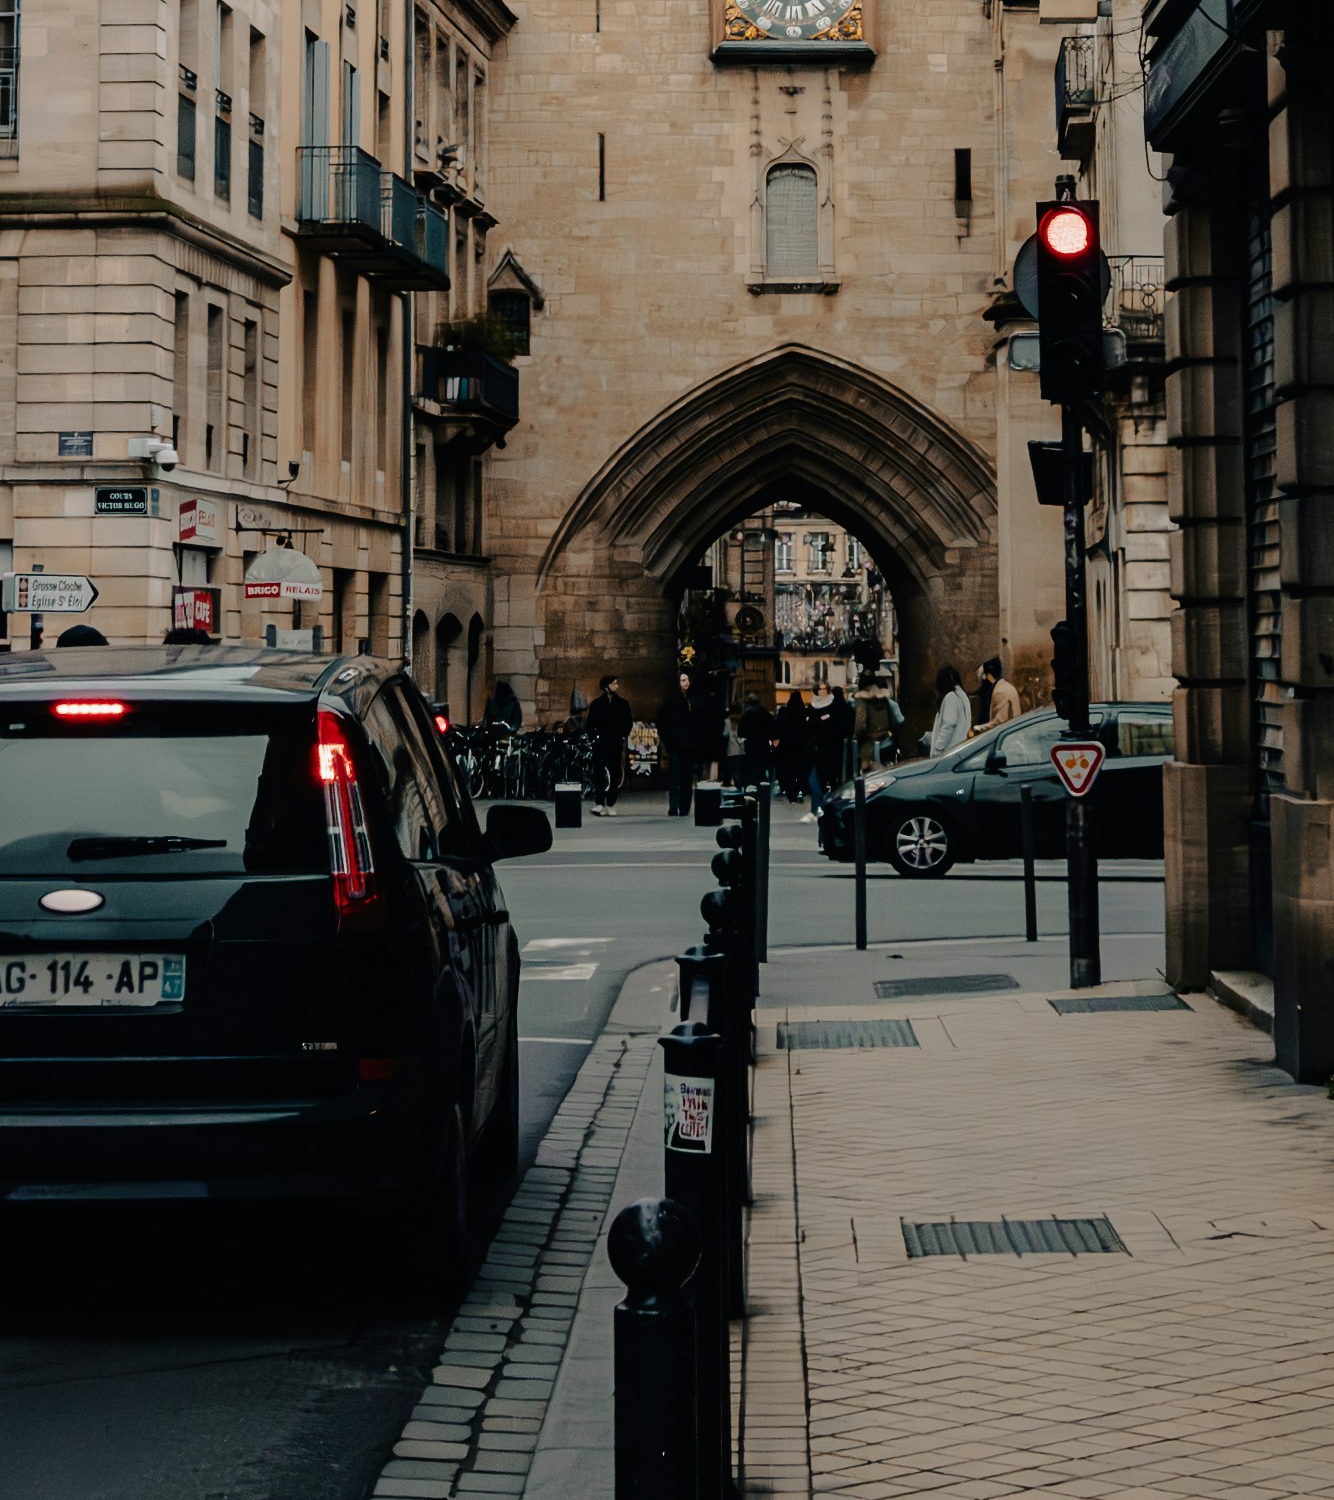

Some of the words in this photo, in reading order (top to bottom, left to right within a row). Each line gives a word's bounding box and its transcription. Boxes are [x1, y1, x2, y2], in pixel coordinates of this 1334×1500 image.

[98, 502, 123, 510] VICTOR
[247, 586, 279, 595] BRICO
[286, 586, 320, 595] RELAIS
